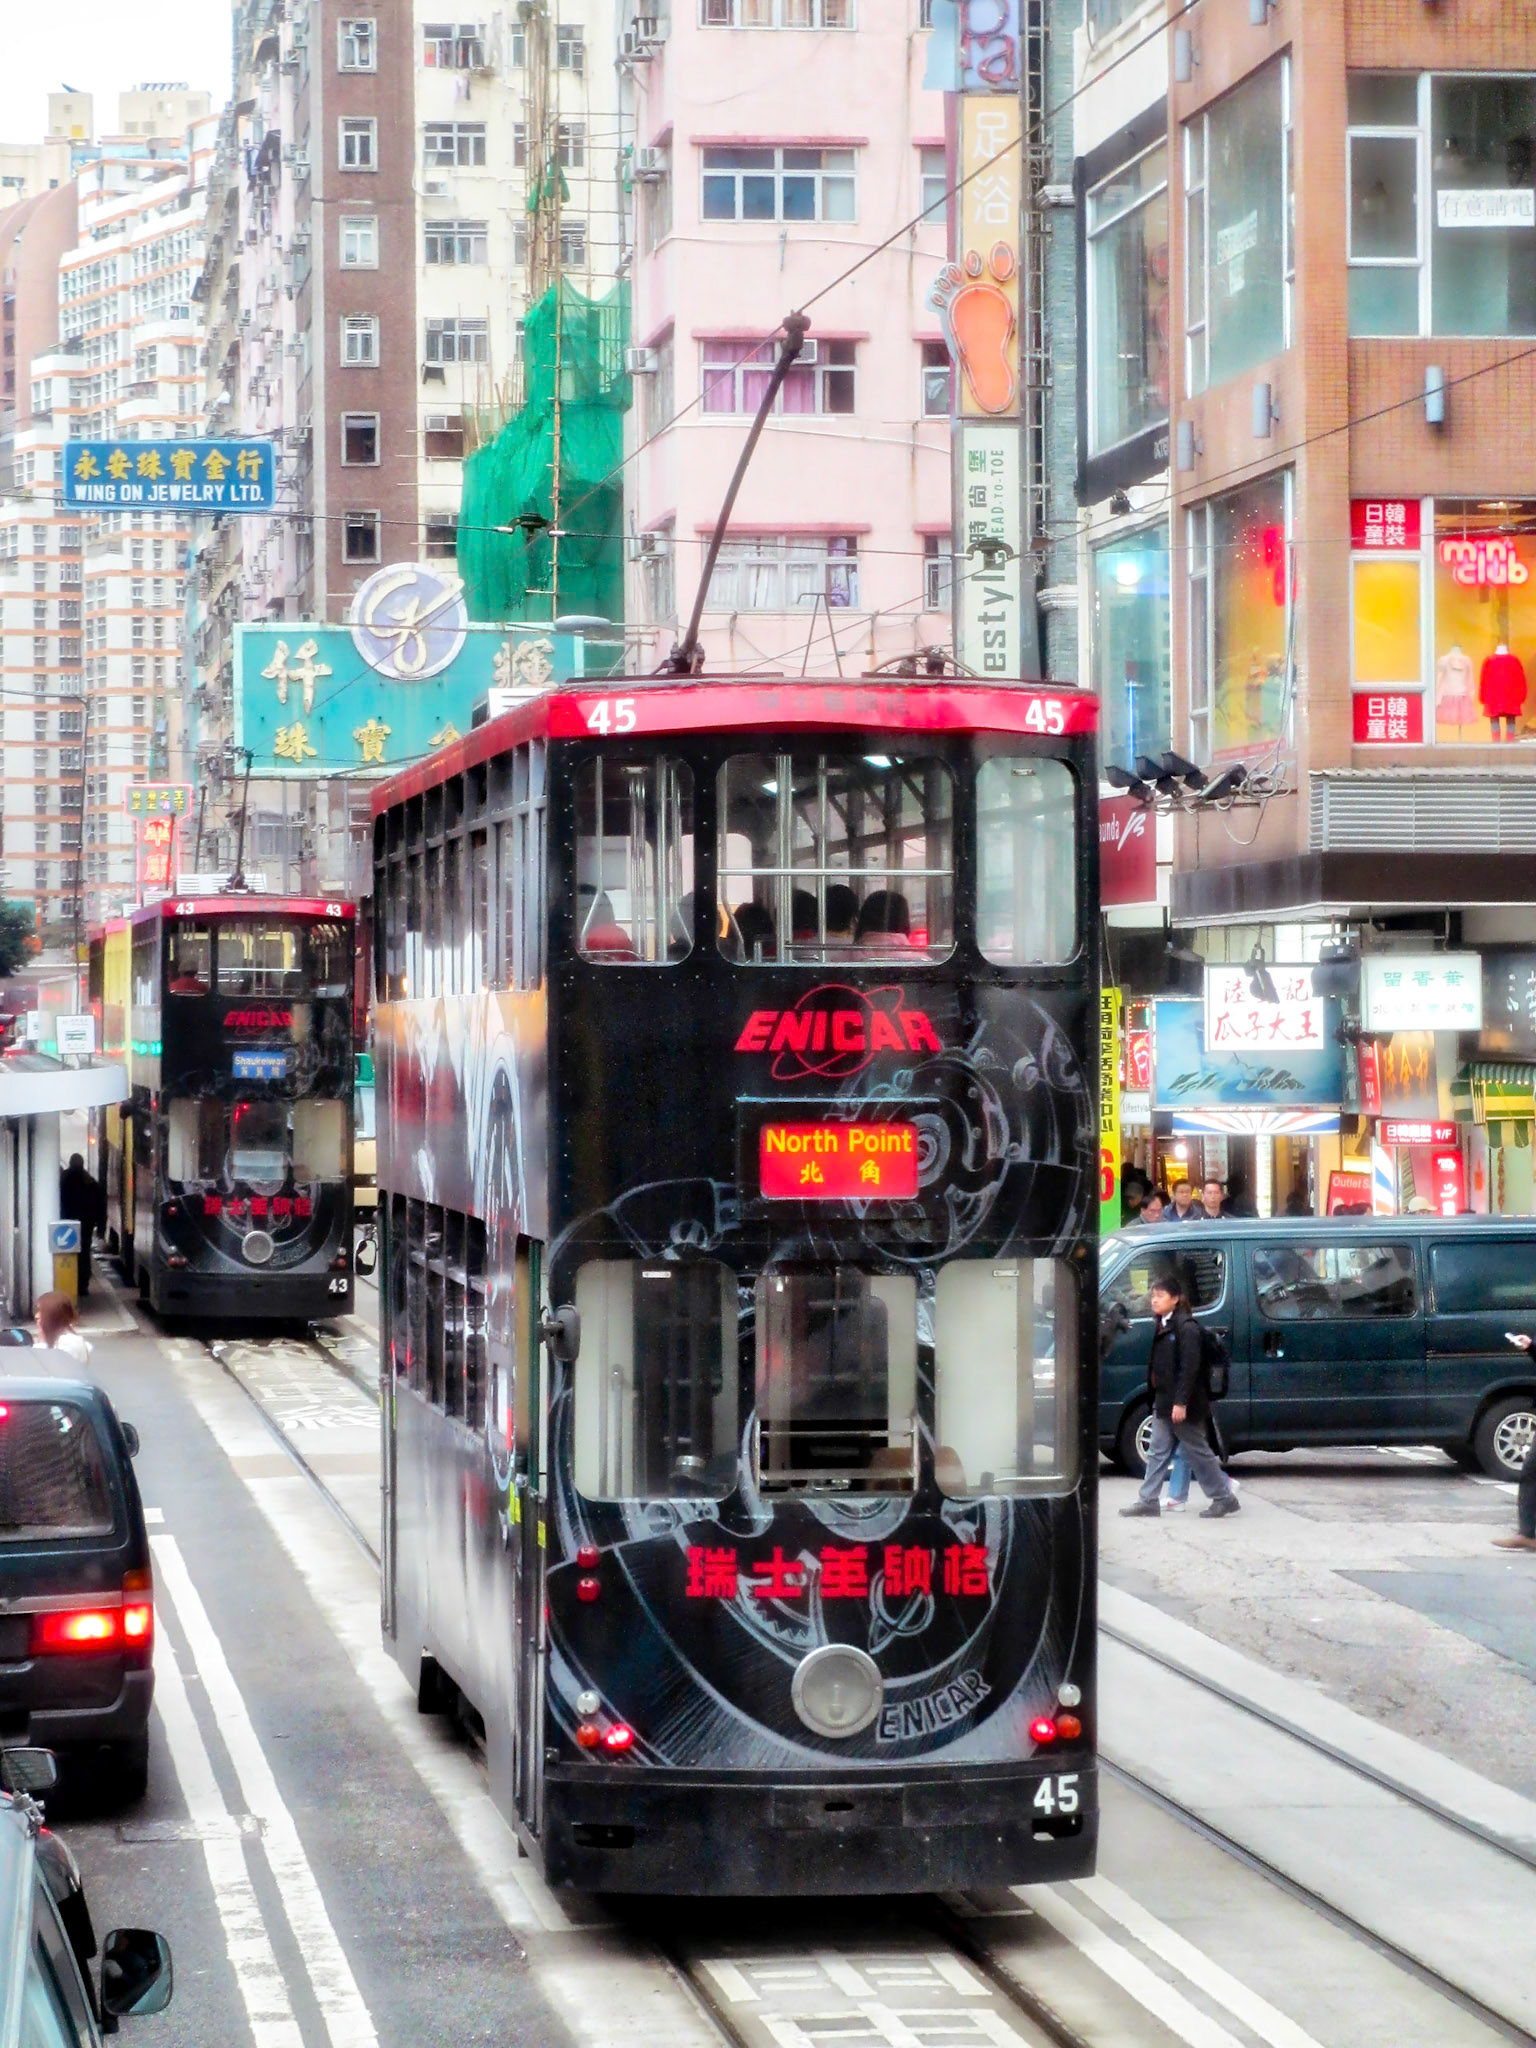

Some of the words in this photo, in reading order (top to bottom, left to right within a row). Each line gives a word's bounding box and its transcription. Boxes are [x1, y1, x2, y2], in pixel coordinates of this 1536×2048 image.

[971, 111, 1011, 224] 足浴
[74, 448, 264, 481] 永安珠寶金行
[74, 484, 116, 501] WING
[120, 484, 143, 501] ON
[148, 484, 225, 502] JEWELRY
[230, 484, 264, 502] LTD.
[1441, 540, 1516, 564] mini
[1454, 550, 1528, 585] club
[587, 698, 637, 735] 45
[1025, 699, 1064, 734] 45
[176, 902, 194, 915] 43
[326, 903, 342, 917] 43
[224, 1011, 296, 1027] ENICAR
[734, 1011, 942, 1051] ENICAR
[1214, 1010, 1319, 1041] 瓜子大王
[766, 1129, 838, 1153] North
[848, 1129, 912, 1153] Point
[800, 1159, 881, 1185] 北角
[1332, 1175, 1361, 1189] Outlet
[328, 1278, 348, 1293] 43
[876, 1669, 992, 1743] ENICAR
[1033, 1774, 1079, 1815] 45
